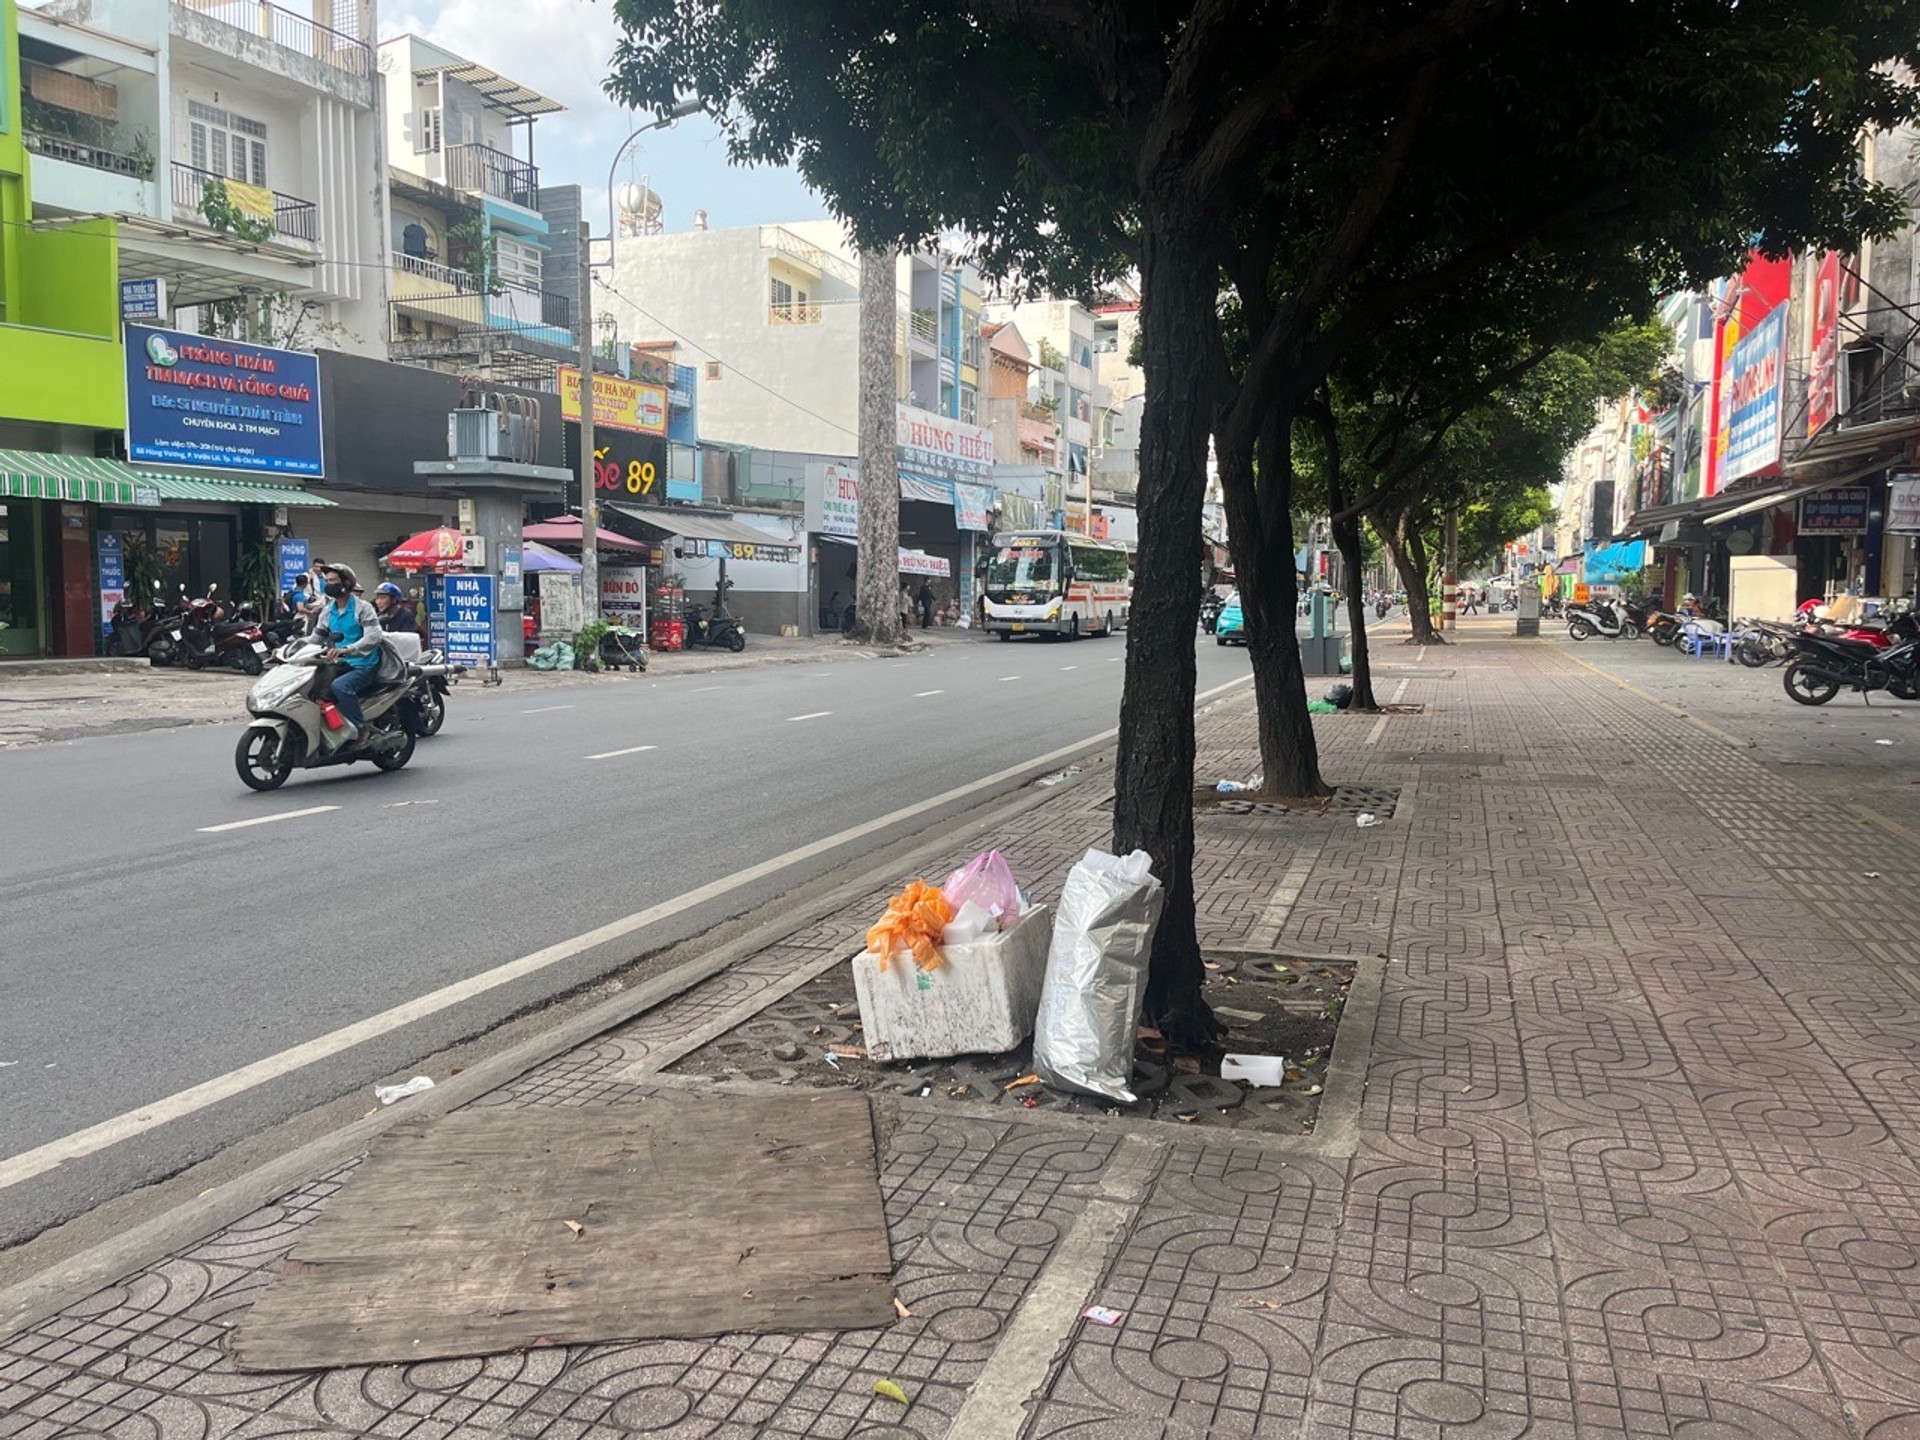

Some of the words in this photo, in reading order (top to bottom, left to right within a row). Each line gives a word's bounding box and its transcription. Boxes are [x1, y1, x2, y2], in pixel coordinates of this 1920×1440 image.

[180, 343, 233, 367] PHÒNG
[235, 352, 276, 374] KHÁM
[173, 370, 217, 389] MẠCH
[237, 373, 276, 397] TỔNG
[279, 382, 311, 402] QUÁT
[604, 382, 617, 396] HÀ
[619, 386, 636, 401] NỘI
[183, 416, 215, 429] CHUYÊN
[216, 420, 237, 431] KHOA
[239, 423, 244, 432] 2
[245, 424, 258, 433] TIM
[910, 417, 954, 454] HÙNG
[627, 460, 655, 495] 89
[733, 543, 754, 558] 89
[903, 556, 928, 569] HÙNG
[456, 578, 480, 591] NHÀ
[603, 578, 623, 594] BÚN
[625, 579, 639, 594] BÒ
[450, 593, 487, 607] THUỐC
[458, 608, 479, 621] TÂY
